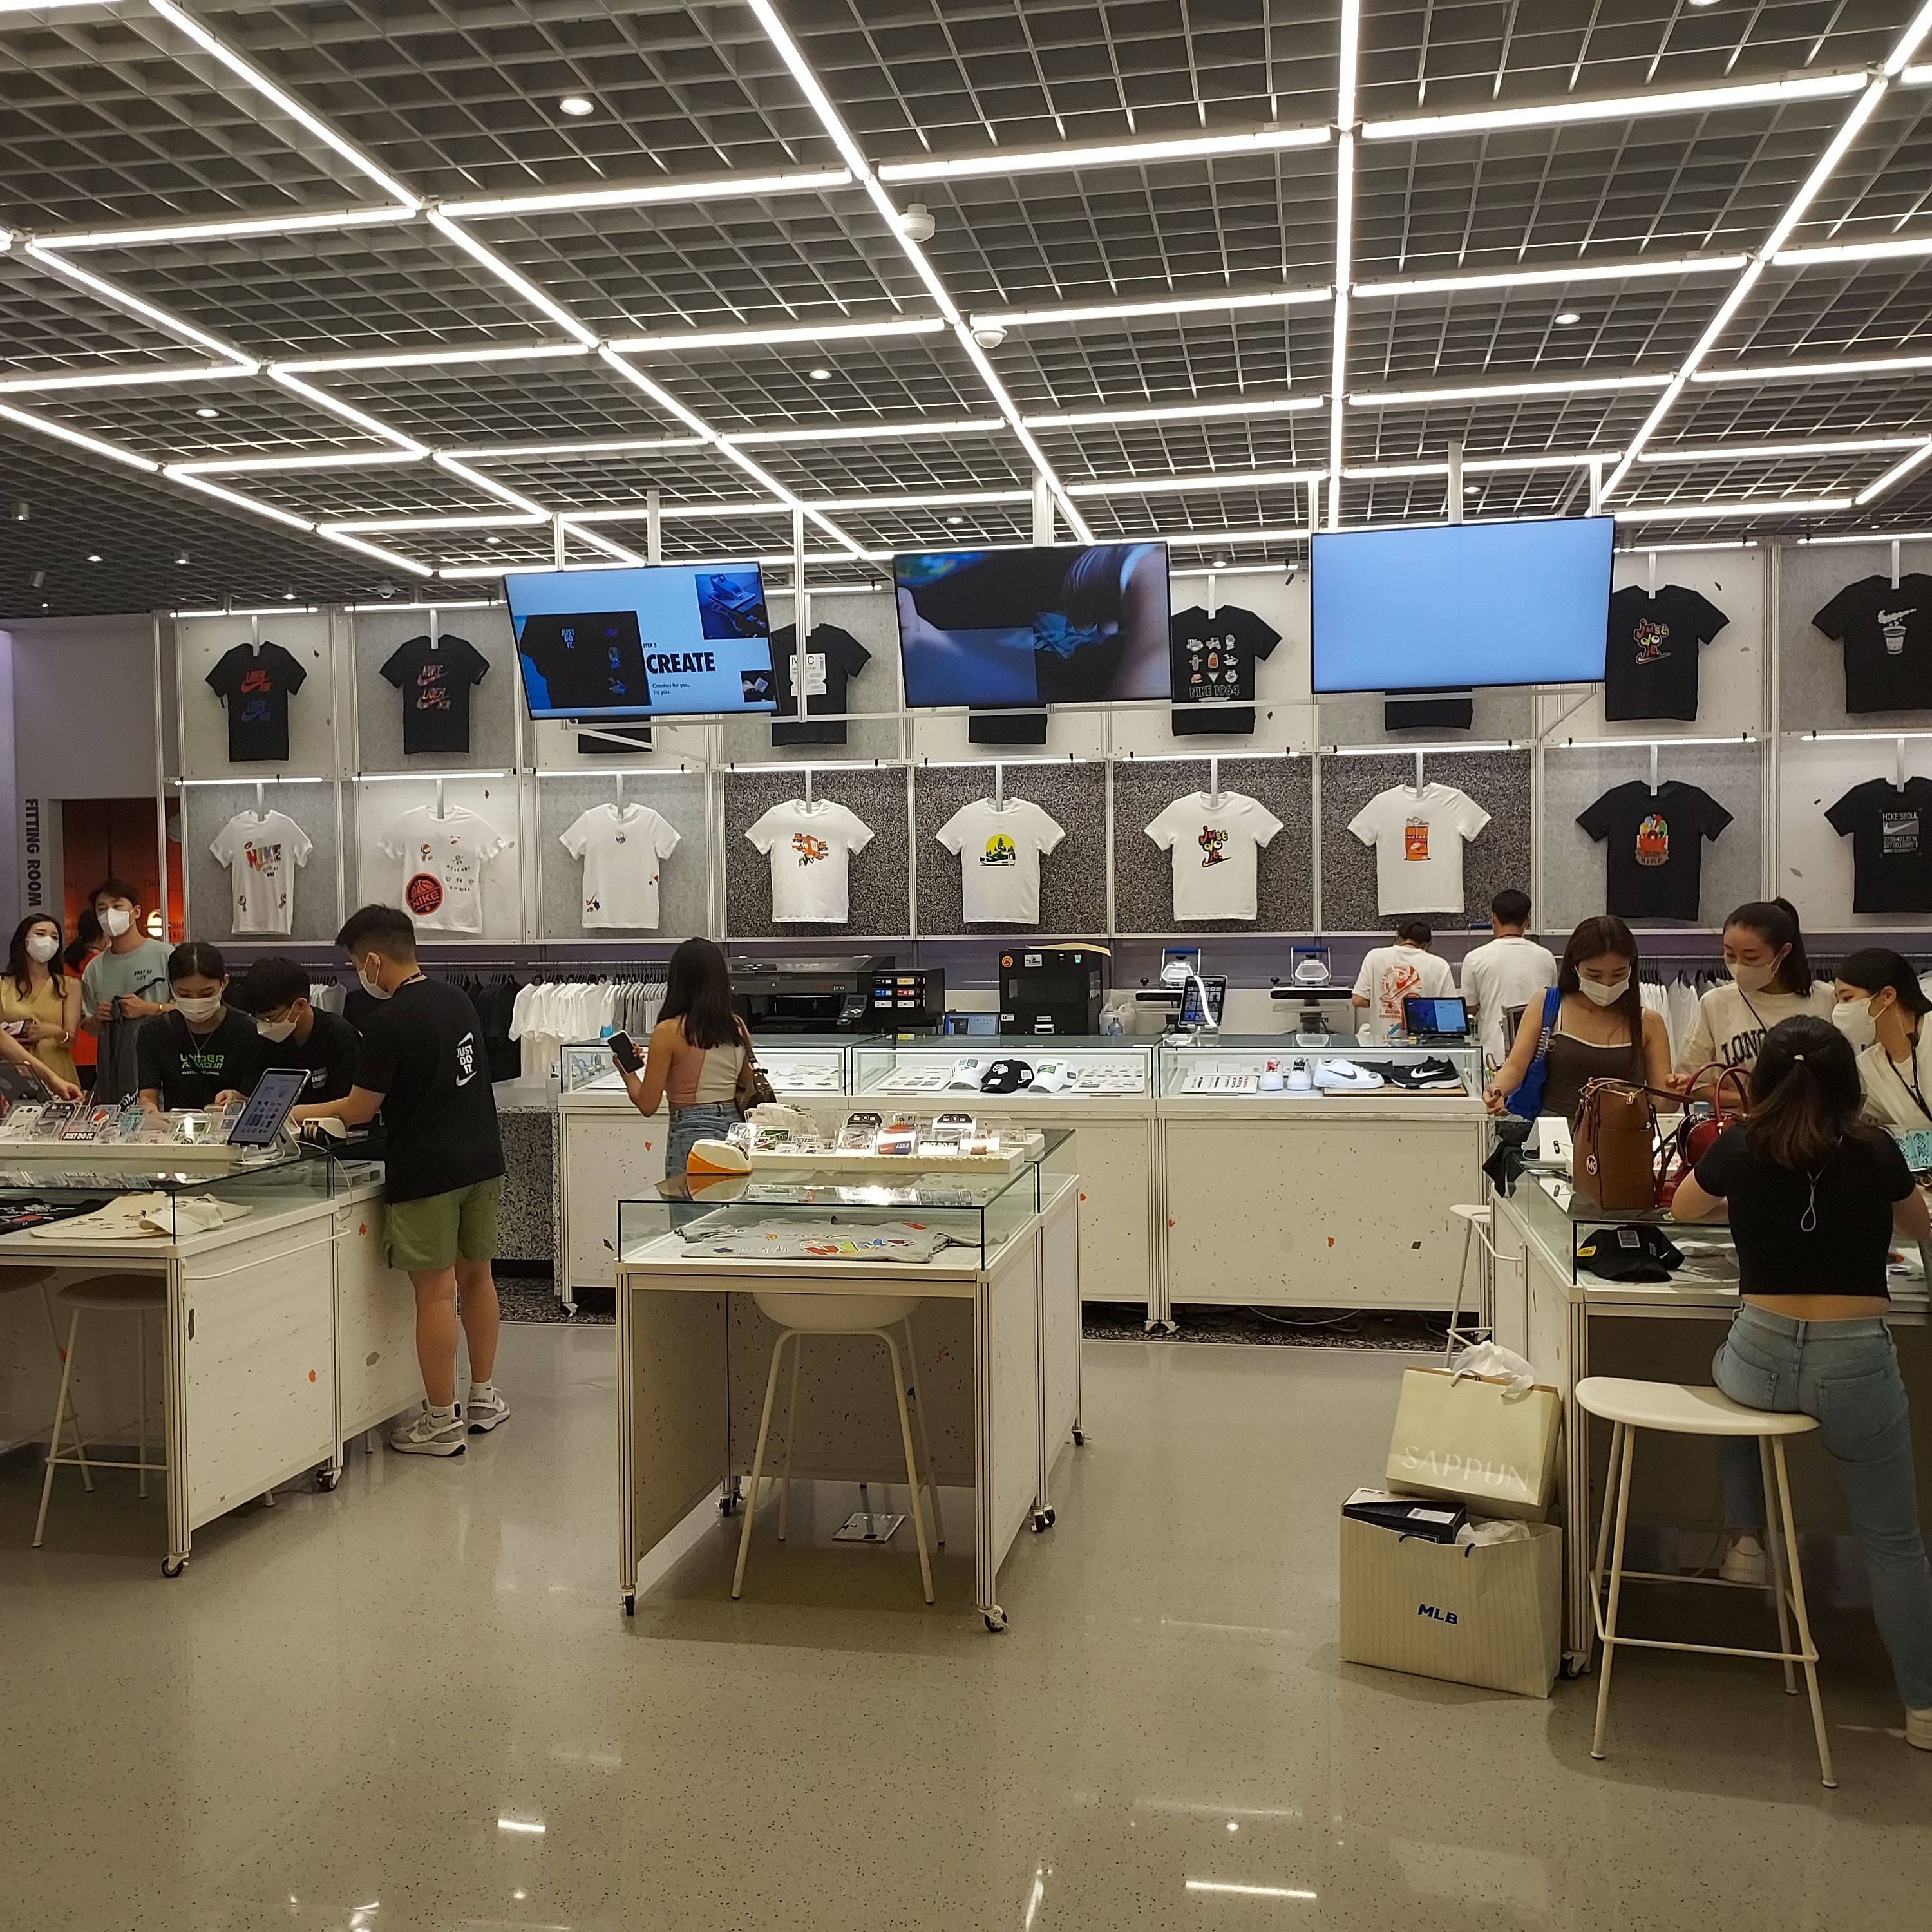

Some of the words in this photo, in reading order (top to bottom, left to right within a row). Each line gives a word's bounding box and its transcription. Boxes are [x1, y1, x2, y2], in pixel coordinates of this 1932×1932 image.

[1640, 633, 1660, 646] do
[646, 652, 716, 674] CREATE
[791, 656, 815, 666] NC
[1189, 685, 1212, 698] NIKE
[1213, 685, 1240, 696] 1964
[1882, 812, 1899, 820] NIKE
[1899, 811, 1918, 820] SEOUL
[25, 799, 41, 855] FITTING
[1204, 839, 1222, 851] do
[27, 859, 42, 907] ROOM
[412, 889, 440, 909] NIKE
[456, 1045, 473, 1058] JUST
[180, 1054, 225, 1063] UNDER
[459, 1054, 473, 1066] DO
[1401, 1445, 1530, 1492] SAPPUN
[1417, 1604, 1458, 1625] MLB
